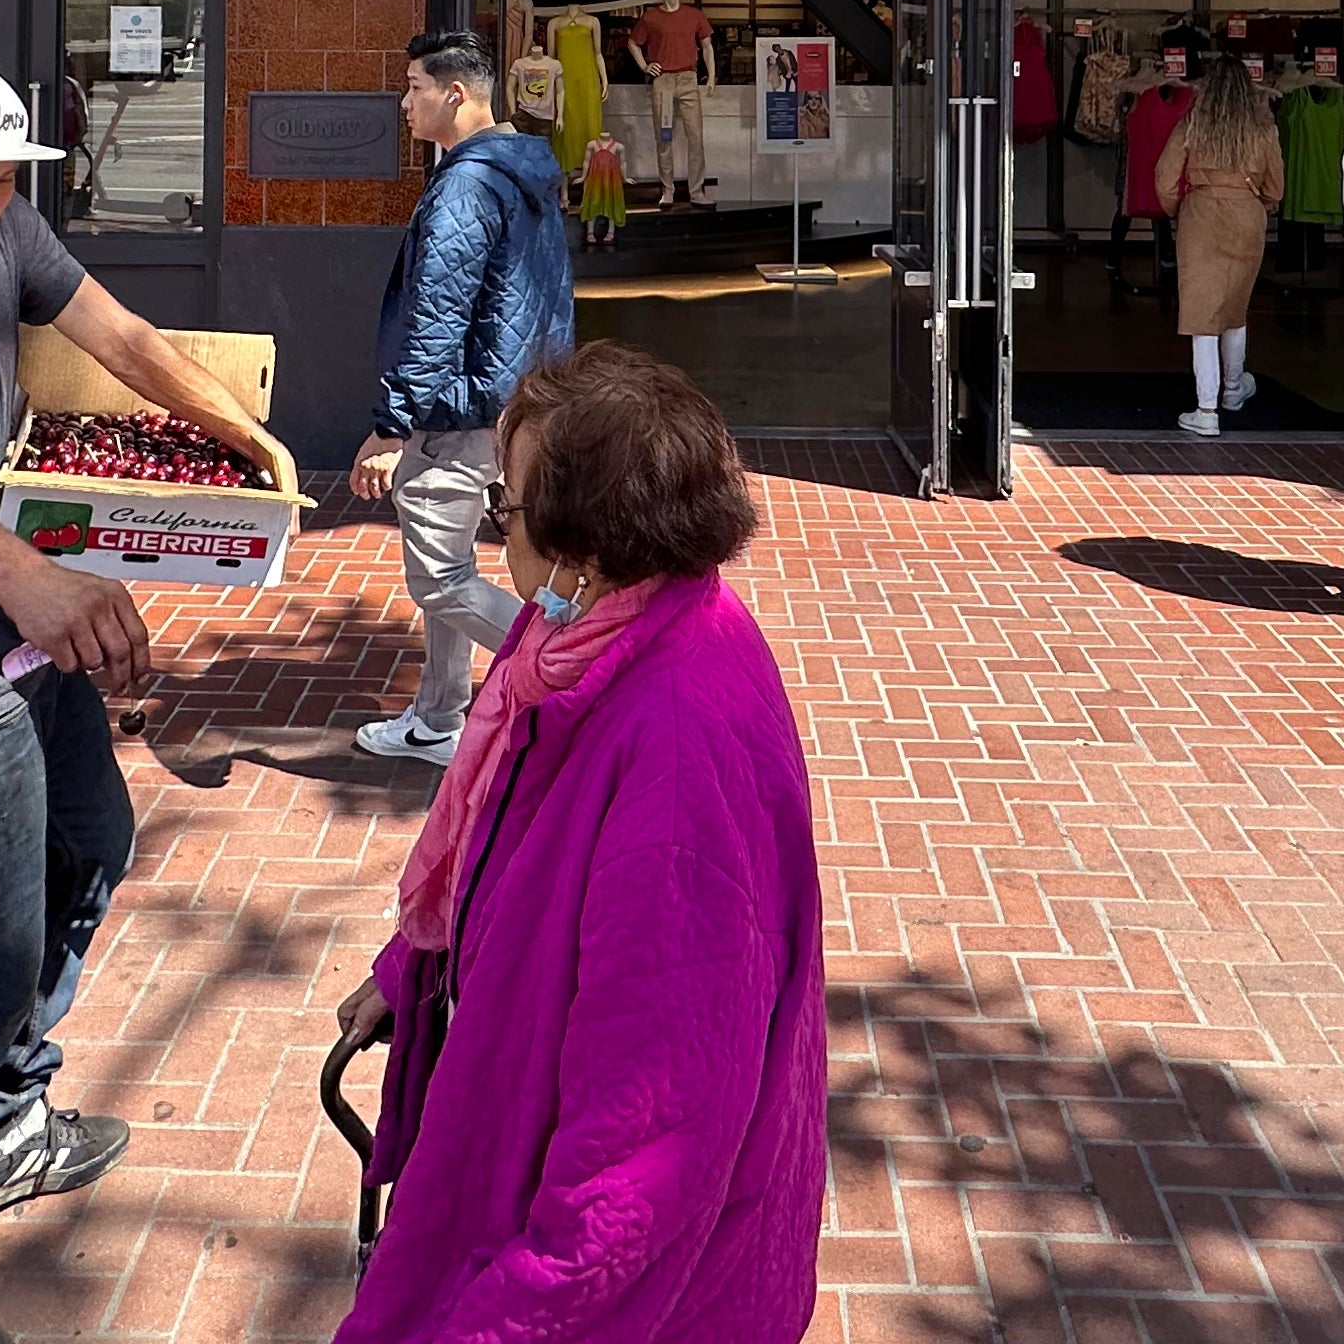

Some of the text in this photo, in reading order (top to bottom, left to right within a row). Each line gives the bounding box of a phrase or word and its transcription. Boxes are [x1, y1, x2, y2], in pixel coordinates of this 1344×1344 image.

[275, 118, 369, 139] OLD NAVY
[109, 507, 259, 532] California
[97, 530, 253, 556] CHERRIES
